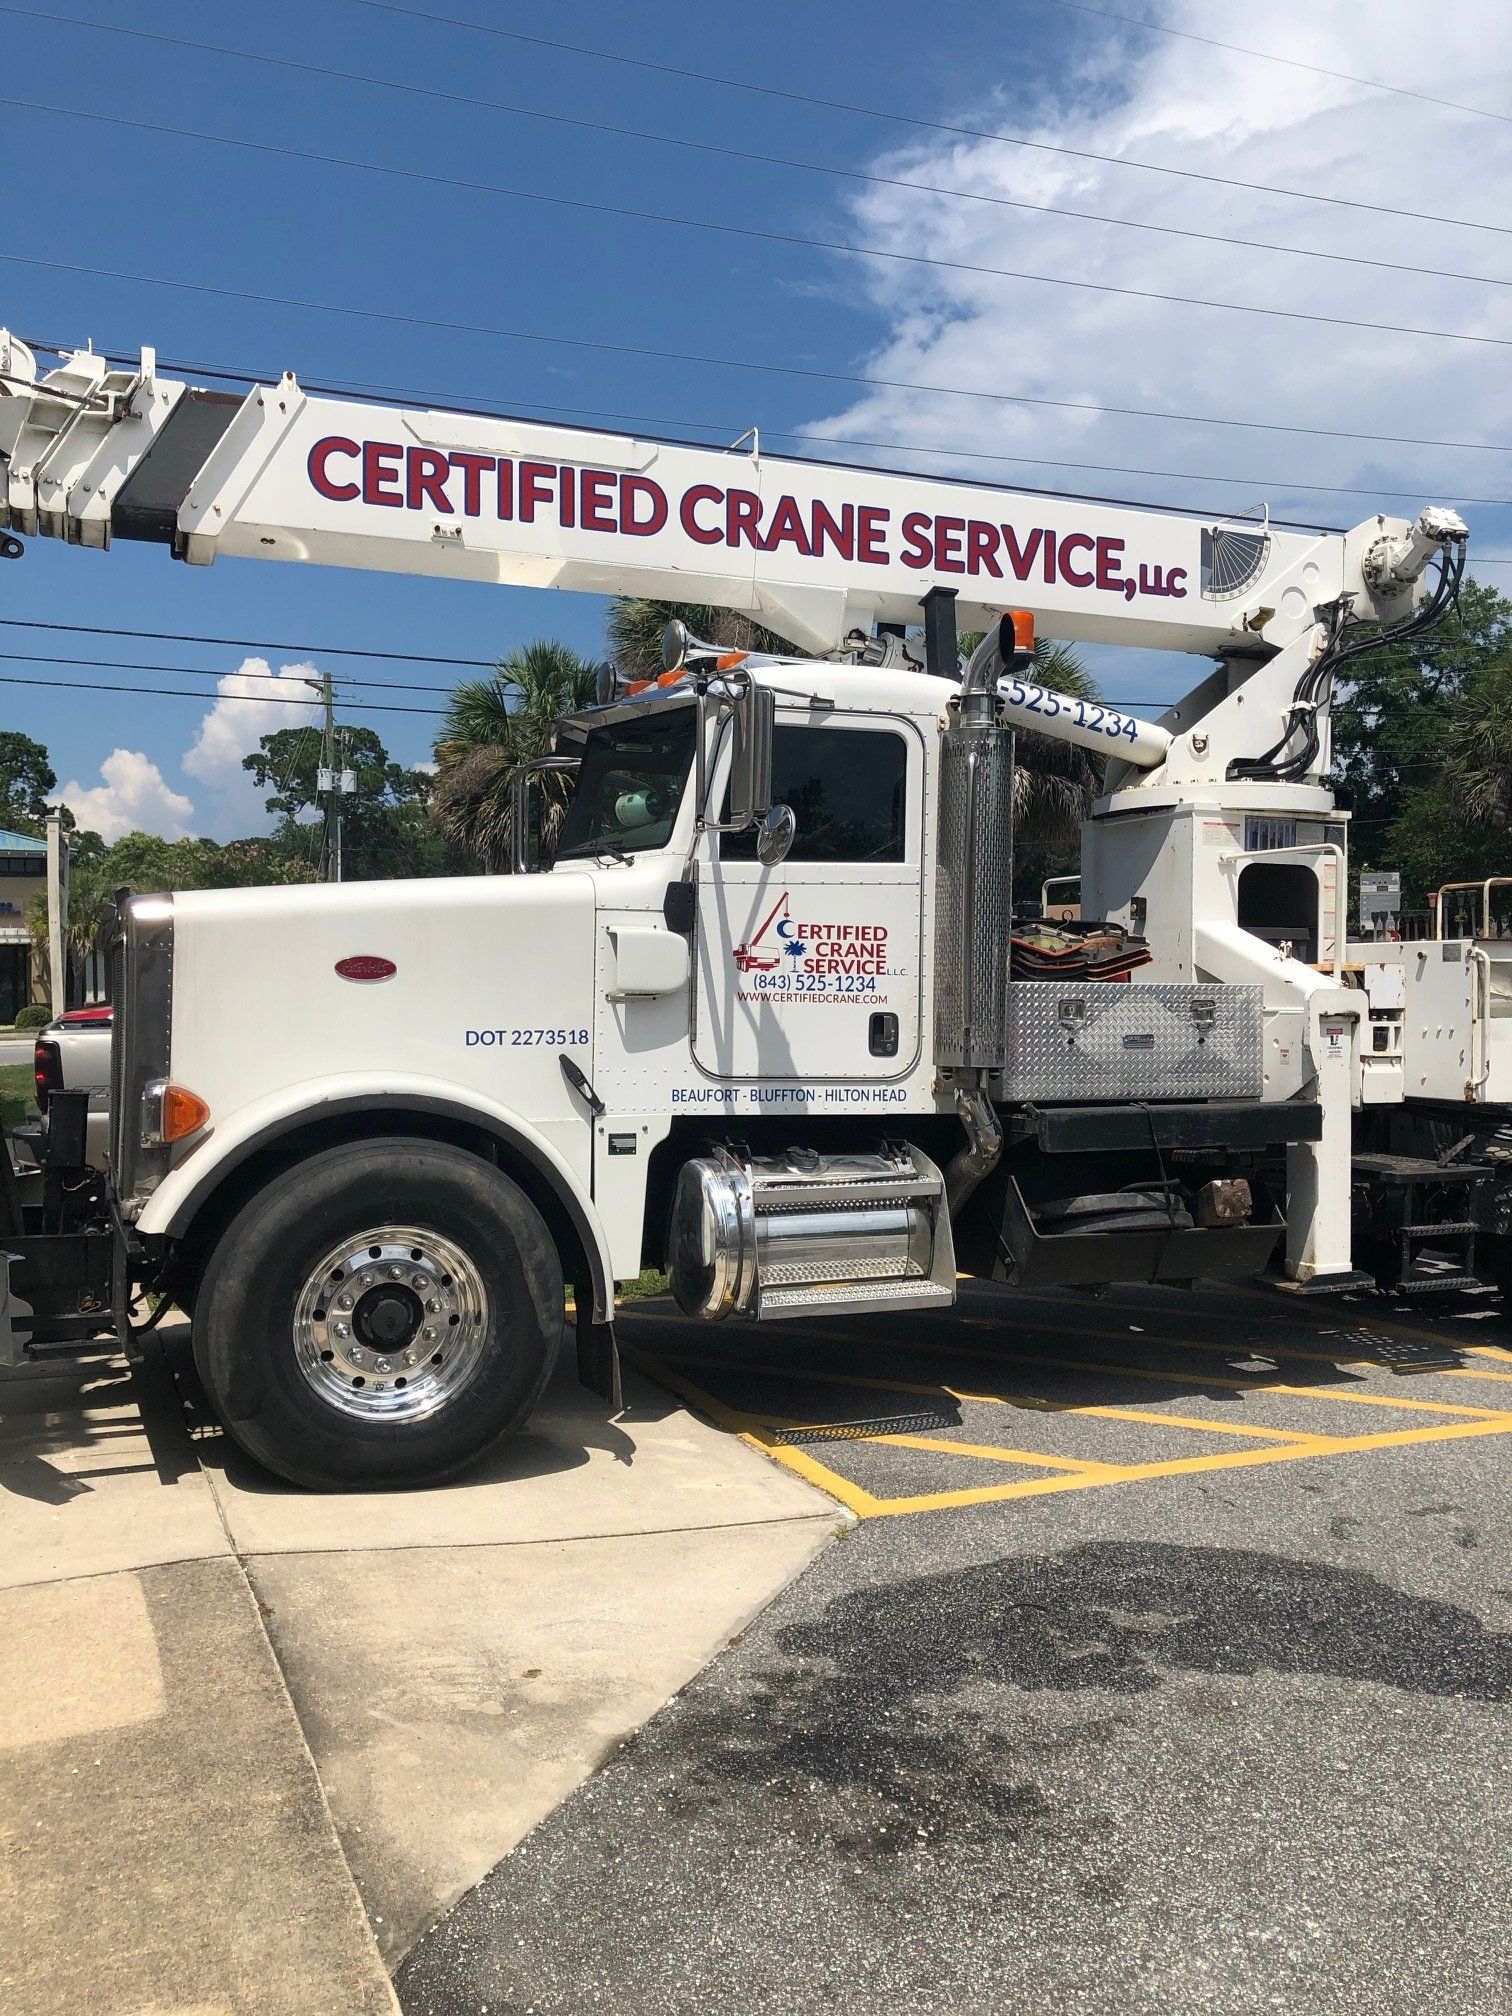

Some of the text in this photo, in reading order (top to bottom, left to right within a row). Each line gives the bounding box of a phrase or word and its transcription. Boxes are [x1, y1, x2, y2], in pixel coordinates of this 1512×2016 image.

[307, 436, 1188, 602] CERTIFIED CRANE SERVICE, LLC
[815, 942, 887, 958] CRANE
[803, 958, 909, 976] SERVICE L.L.C.
[753, 973, 876, 992] (843) 525-1234
[737, 992, 888, 1004] WWW.CERTIFIEDCRANE.COM
[466, 1029, 589, 1046] DOT 2273518
[672, 1089, 740, 1102] BEAUFORT
[750, 1089, 815, 1102] BLUFFTON
[825, 1089, 869, 1102] HILTON
[873, 1089, 907, 1102] HEAD
